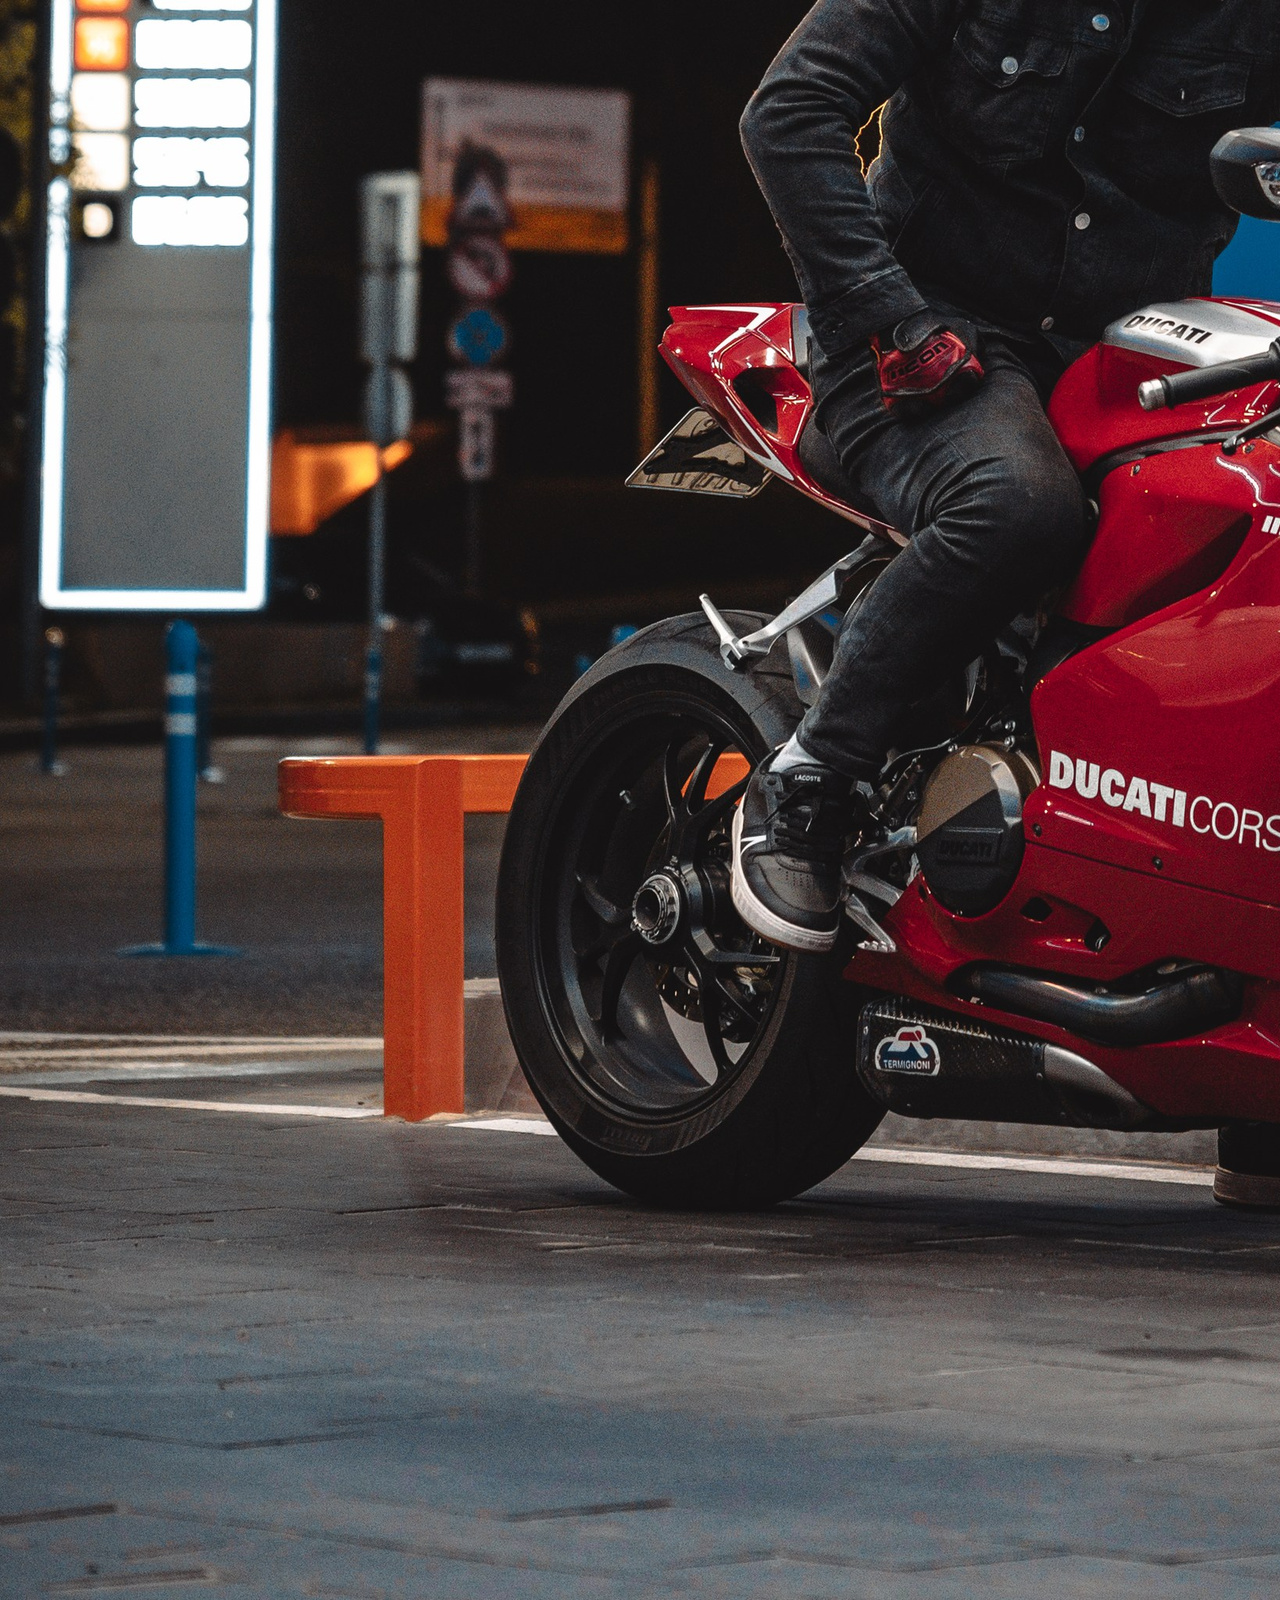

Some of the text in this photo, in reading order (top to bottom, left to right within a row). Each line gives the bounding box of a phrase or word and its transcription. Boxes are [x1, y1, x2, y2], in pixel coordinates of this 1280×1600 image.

[1124, 315, 1212, 344] DUCATI
[794, 774, 821, 782] LACOSTE
[1049, 750, 1188, 828] DUCATI
[883, 1060, 931, 1070] TERMIGNONI
